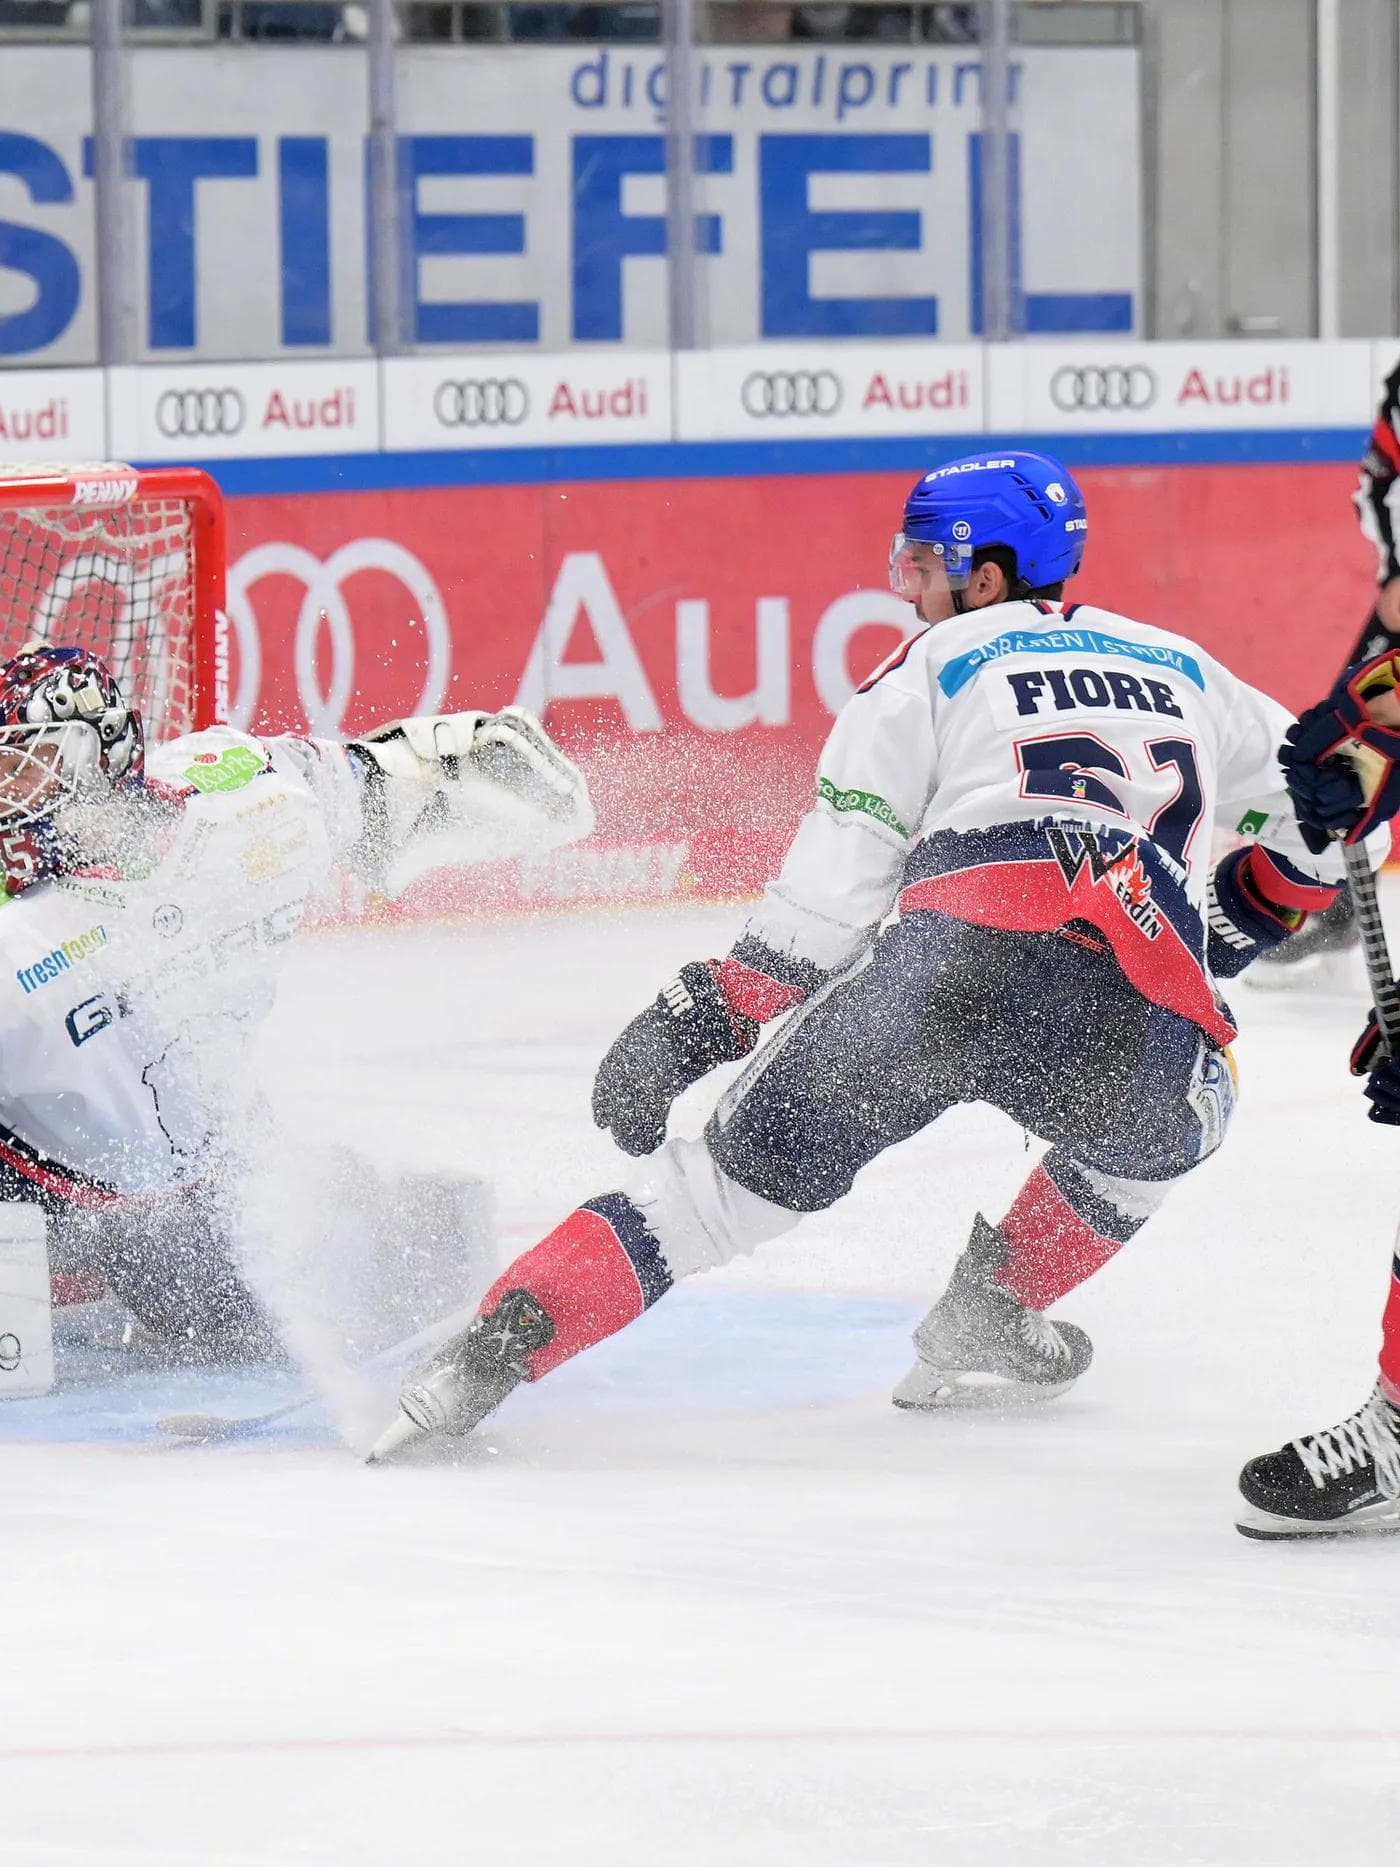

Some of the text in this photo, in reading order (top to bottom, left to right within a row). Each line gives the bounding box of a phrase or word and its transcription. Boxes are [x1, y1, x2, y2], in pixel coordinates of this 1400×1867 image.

[548, 379, 648, 421] Audi
[861, 371, 969, 412] Audi
[1177, 366, 1290, 408] Audi
[262, 388, 356, 431] Audi
[924, 459, 1016, 483] STADLER
[1006, 669, 1184, 720] FIORE
